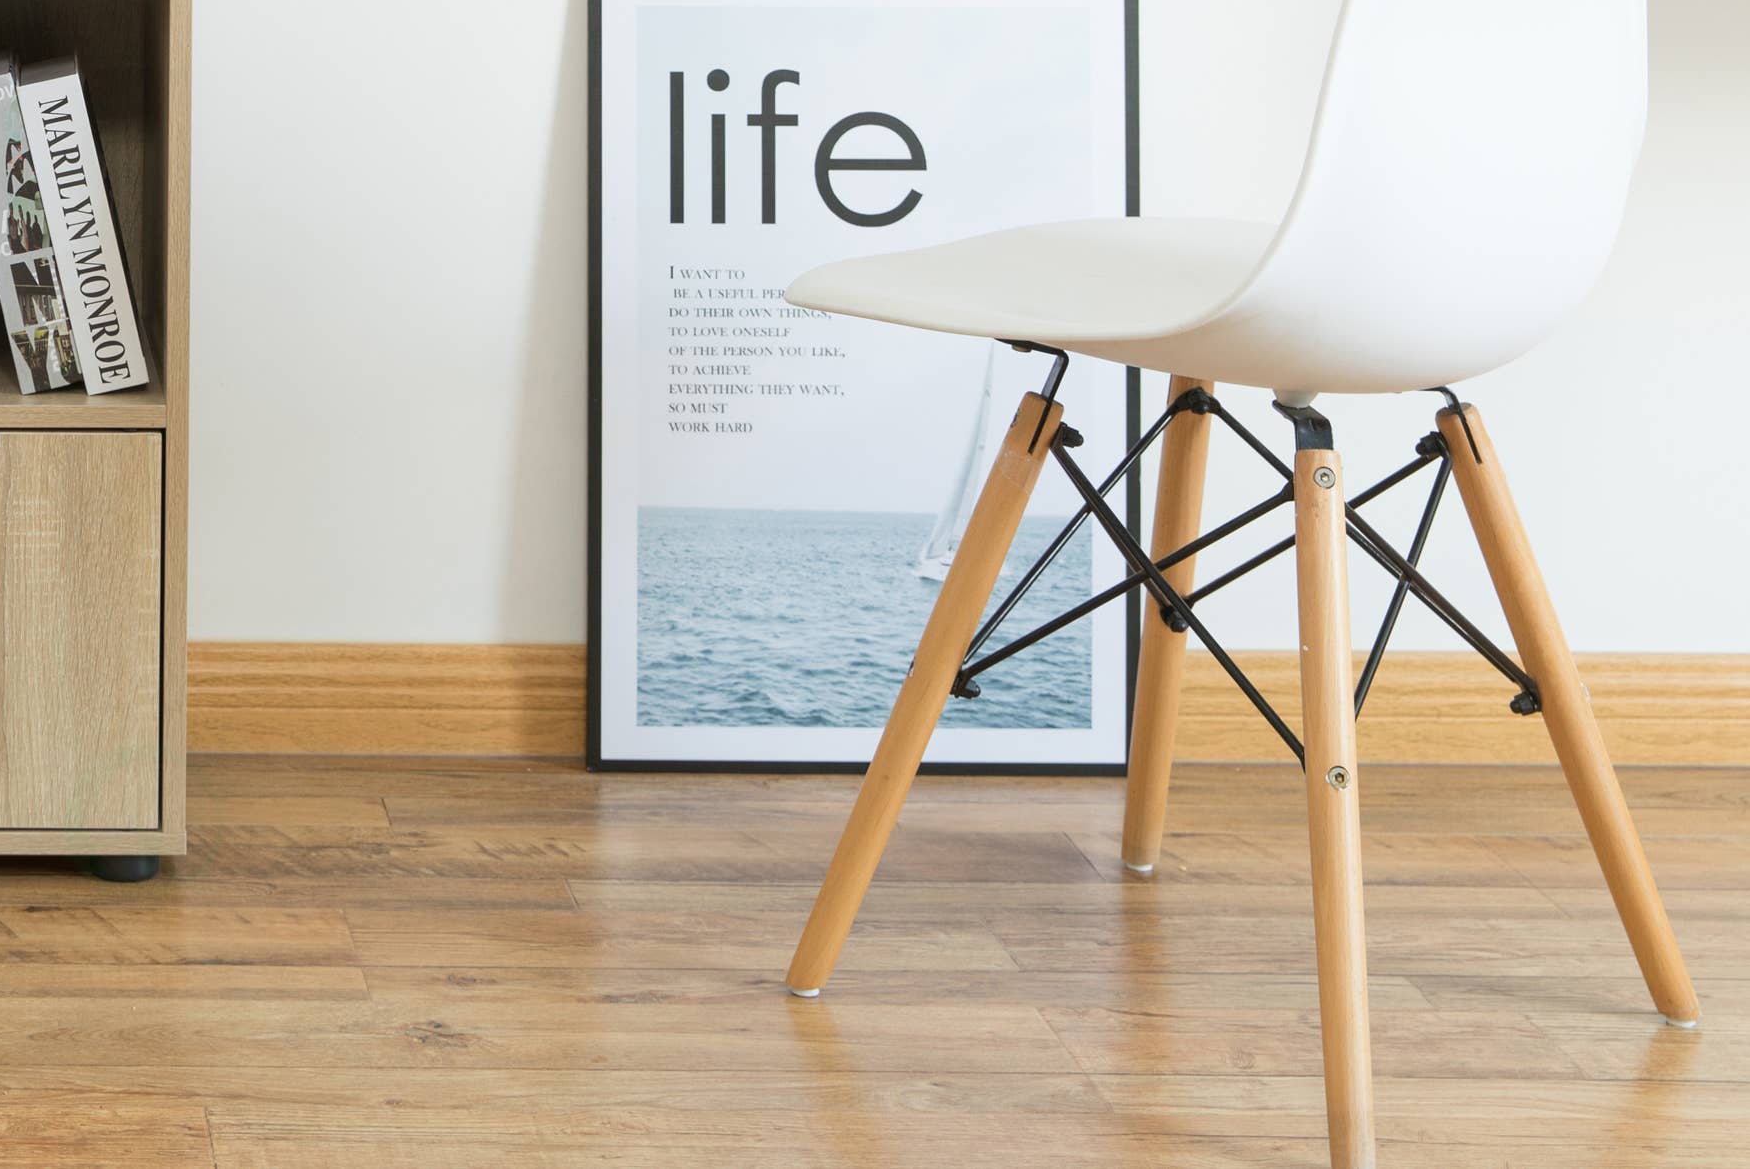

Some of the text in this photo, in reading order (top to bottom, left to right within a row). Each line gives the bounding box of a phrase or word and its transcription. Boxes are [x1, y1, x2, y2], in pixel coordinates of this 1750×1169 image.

[669, 68, 927, 228] life
[39, 96, 132, 385] MARILYN MONROE
[669, 265, 746, 280] I WANT TO
[673, 288, 785, 300] BE A USEFUL PER
[669, 307, 689, 318] DO
[694, 307, 735, 318] THEIR
[738, 308, 773, 319] OWN
[669, 327, 791, 337] TO LOVE ONESELF
[668, 346, 846, 358] OF THE PERSON YOU LIKE,
[668, 365, 751, 376] TO ACHIEVE
[668, 384, 845, 397] EVERYTHING THEY WANT,
[668, 403, 728, 414] SO MUST
[668, 422, 753, 433] WORK HARD
